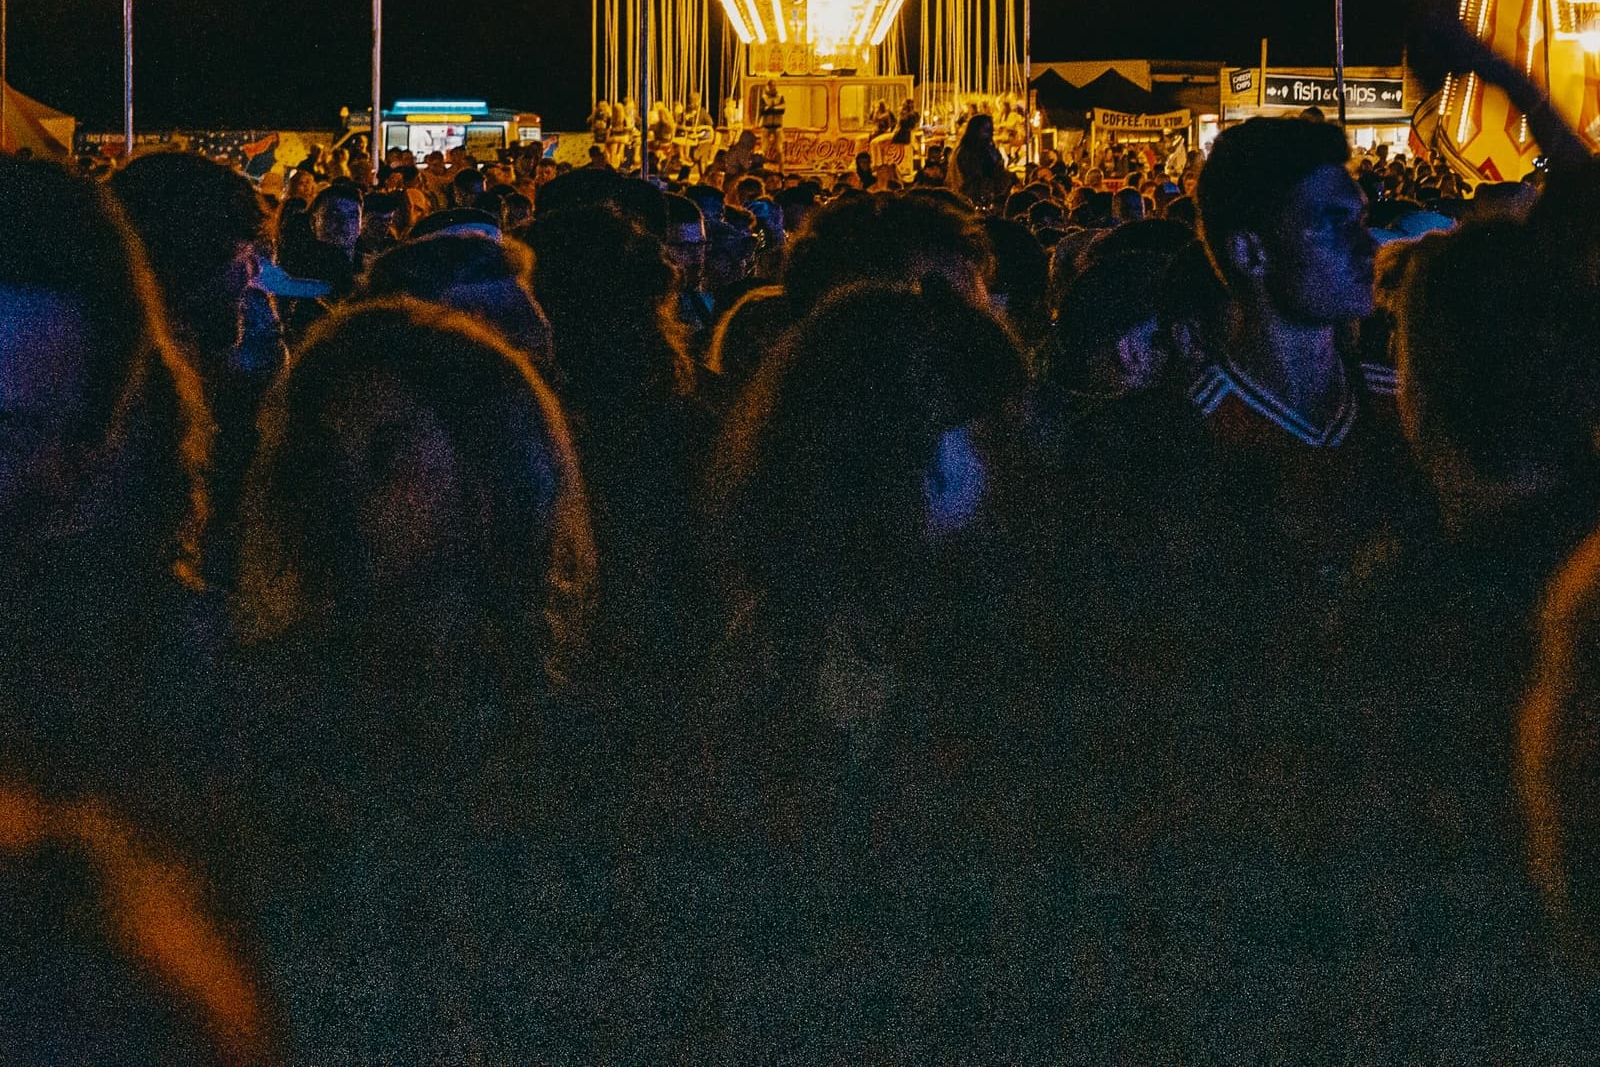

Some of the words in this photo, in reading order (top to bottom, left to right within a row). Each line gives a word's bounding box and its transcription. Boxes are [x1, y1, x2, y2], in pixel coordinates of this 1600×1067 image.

[1293, 80, 1322, 101] fish
[1323, 88, 1331, 100] &
[1332, 83, 1377, 106] chips
[1144, 117, 1162, 127] FULL
